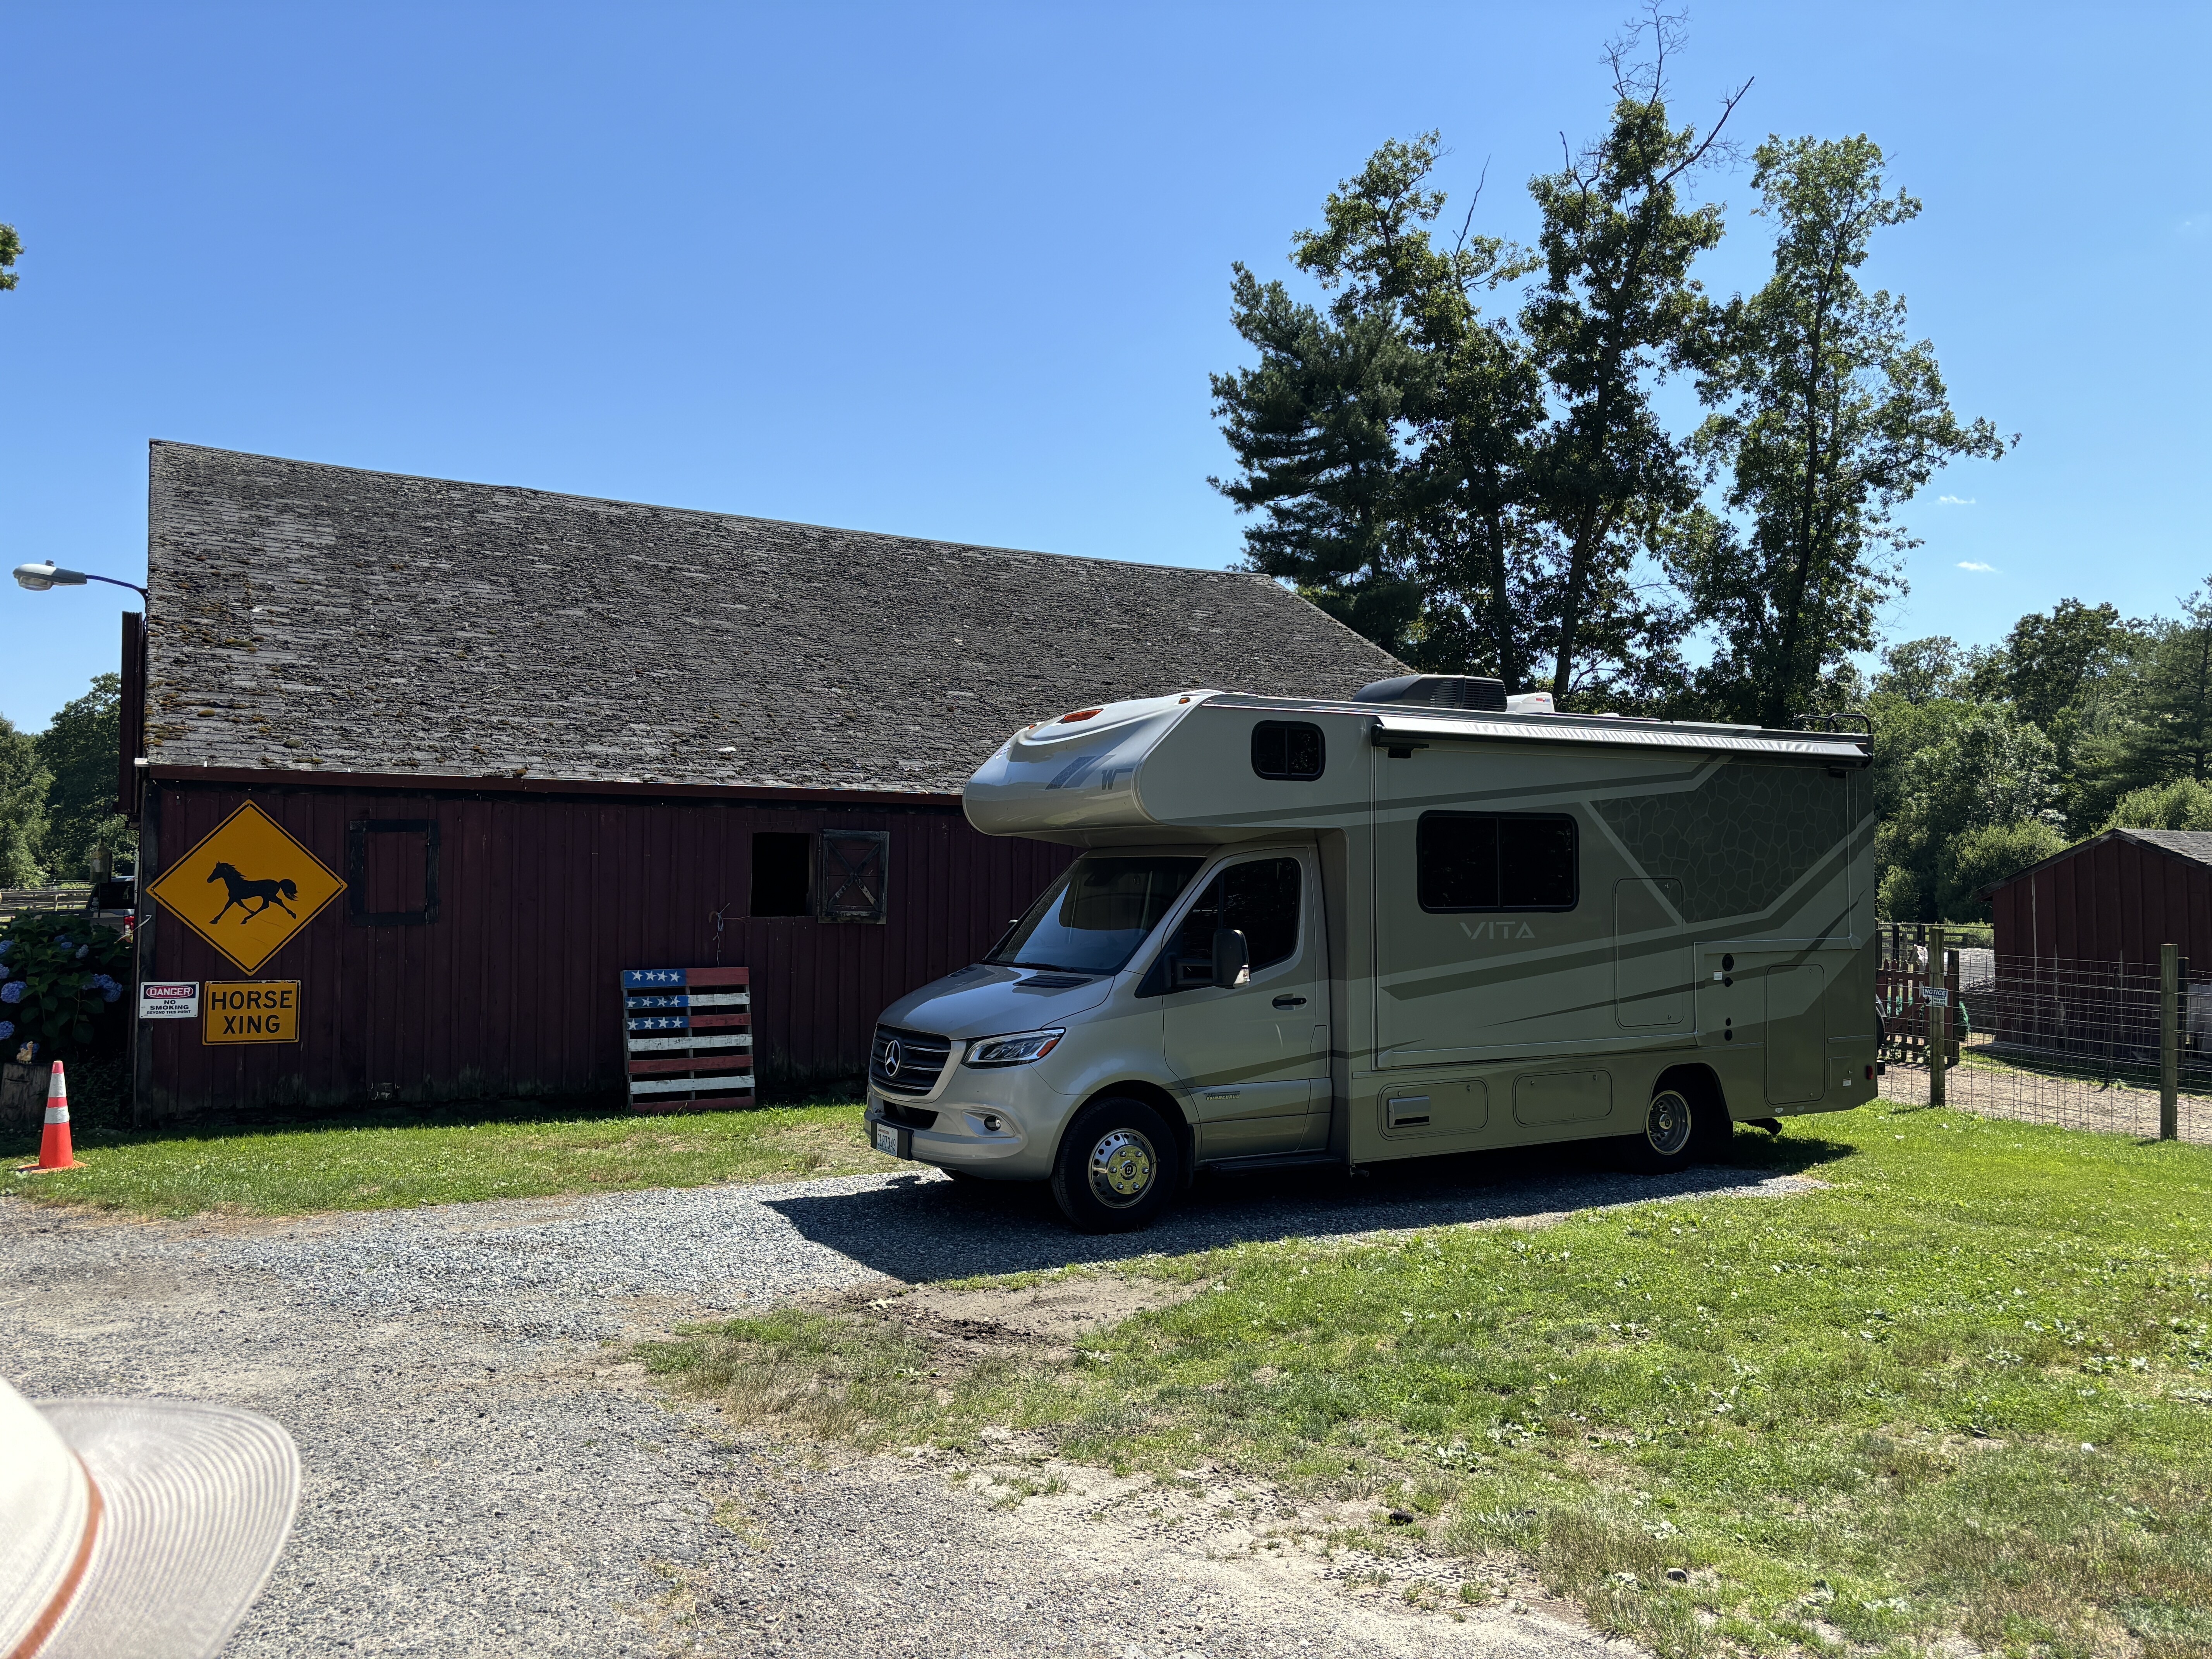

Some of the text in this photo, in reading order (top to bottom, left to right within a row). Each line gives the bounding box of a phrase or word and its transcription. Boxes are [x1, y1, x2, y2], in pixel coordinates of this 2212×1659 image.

[1459, 921, 1535, 940] VITA
[211, 990, 293, 1010] HORSE
[223, 1014, 280, 1034] XING
[878, 1133, 896, 1151] CLP7349
